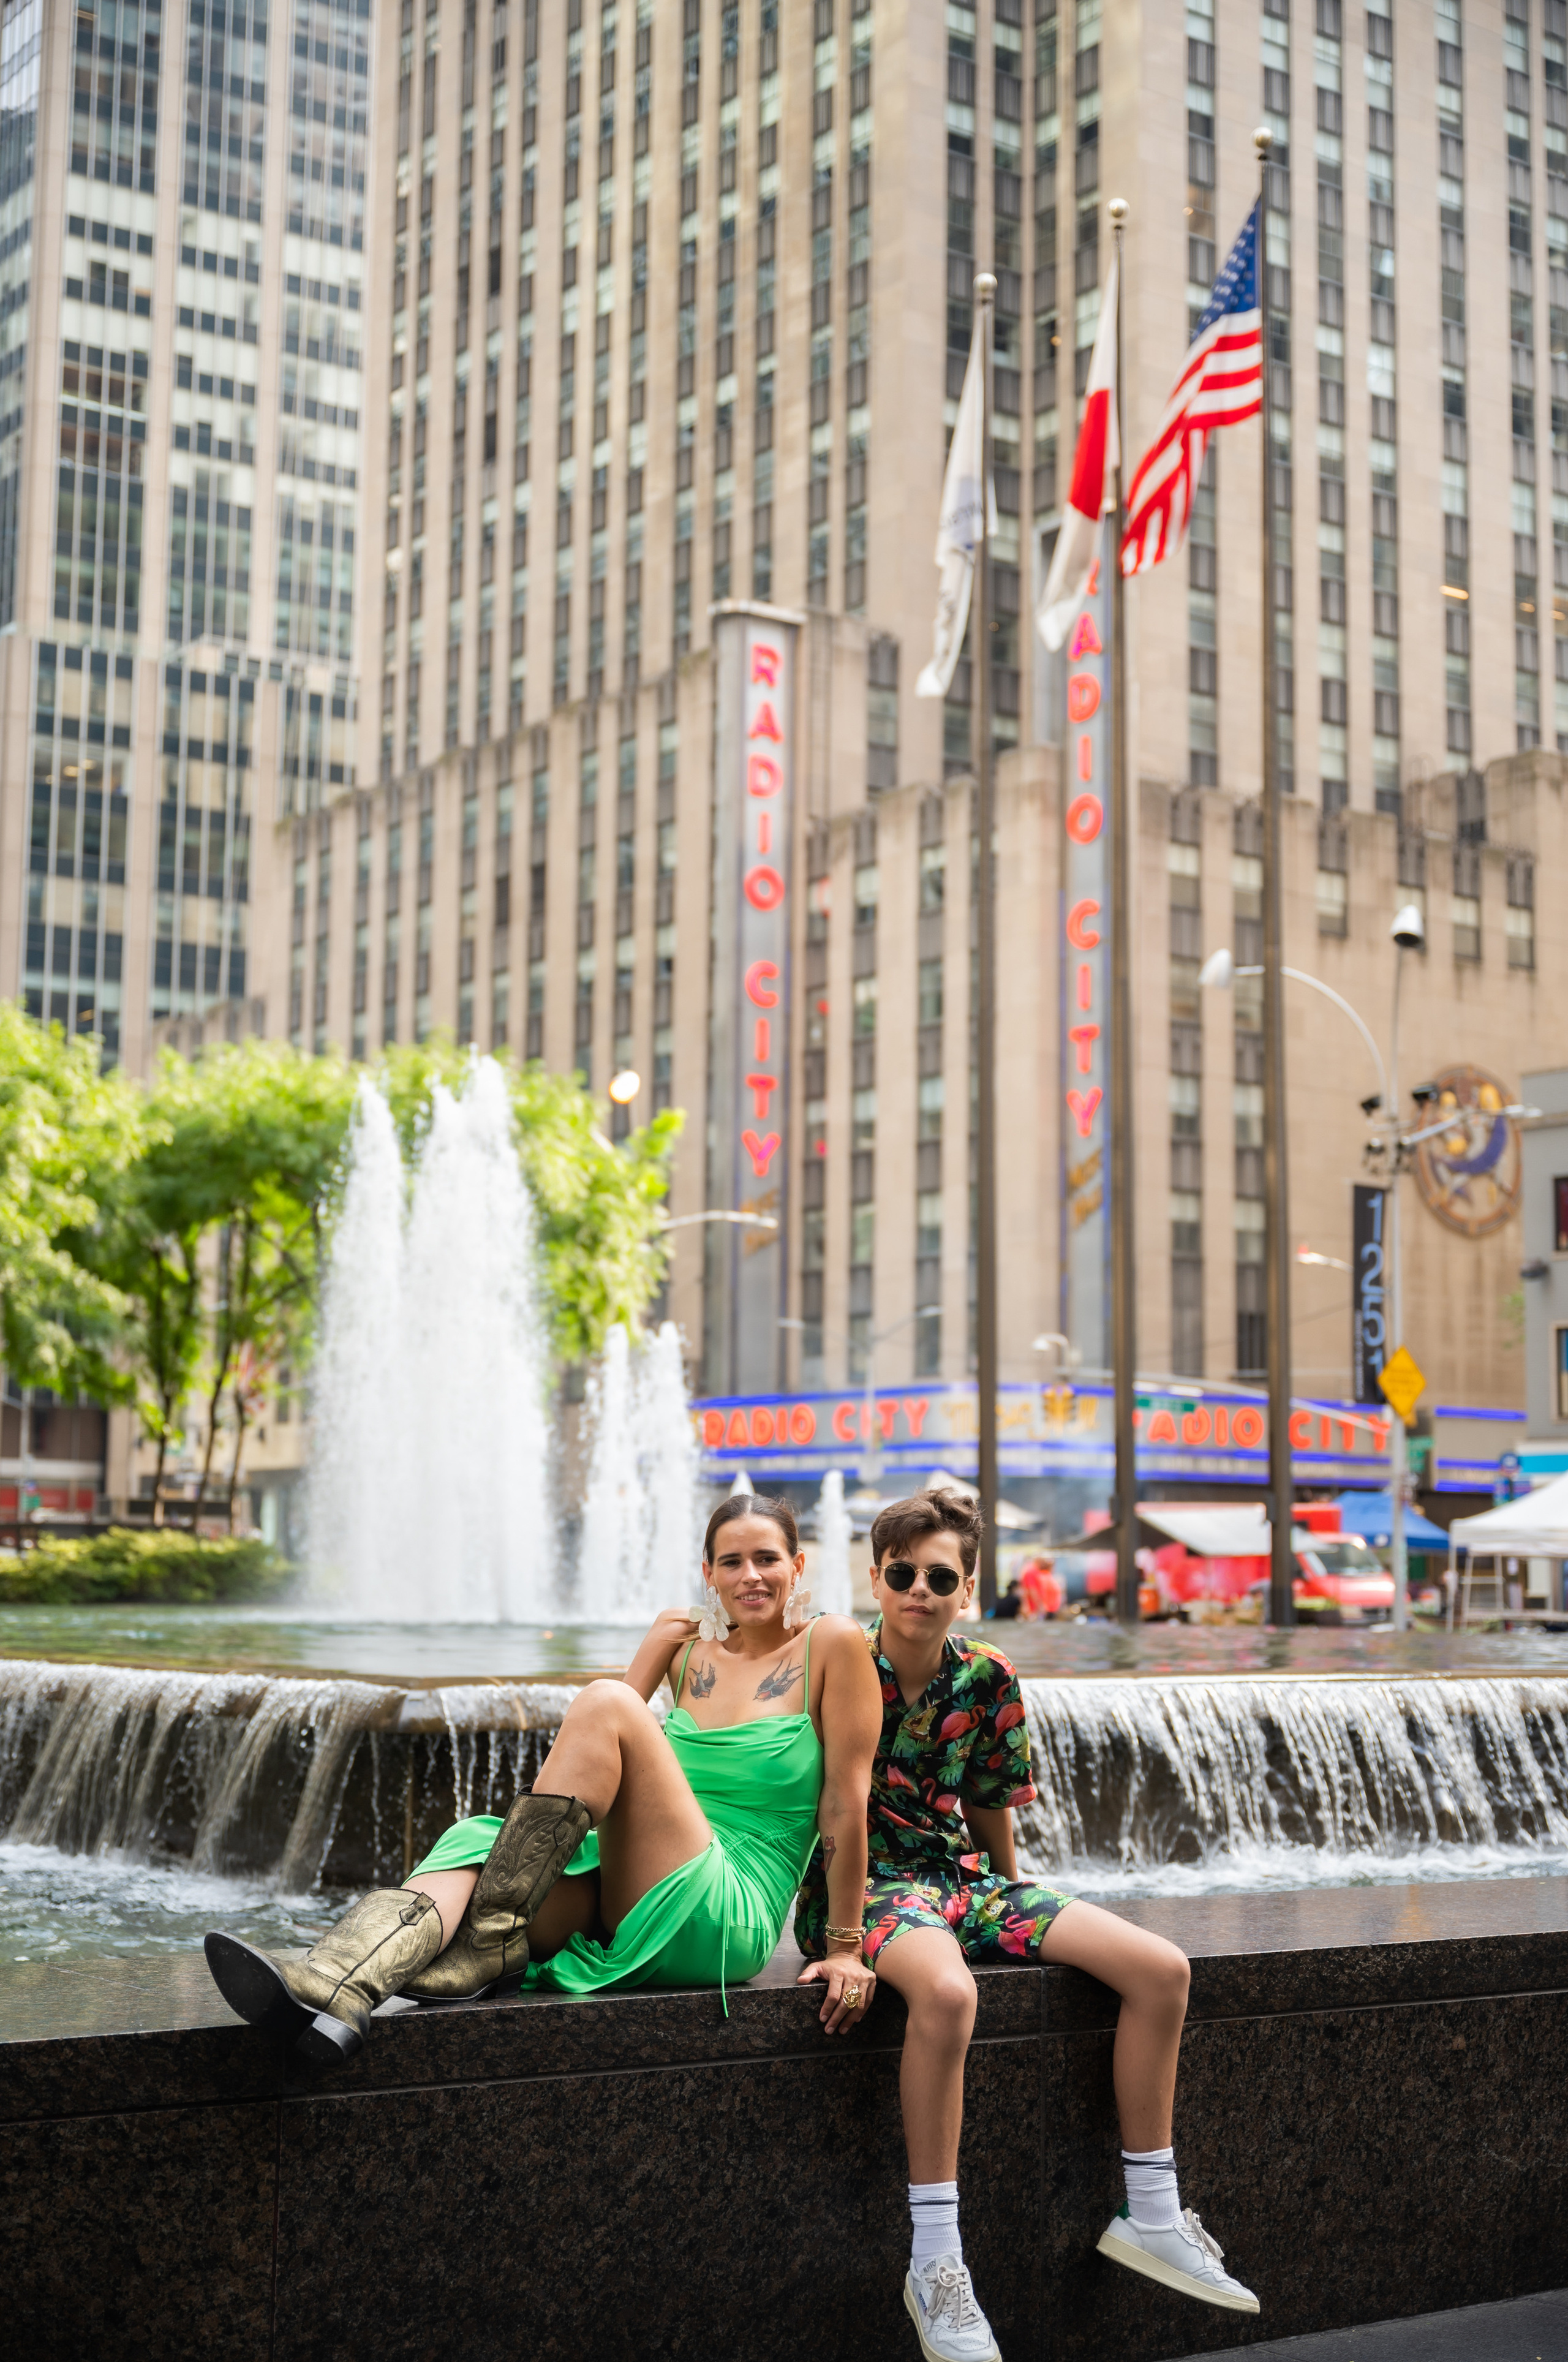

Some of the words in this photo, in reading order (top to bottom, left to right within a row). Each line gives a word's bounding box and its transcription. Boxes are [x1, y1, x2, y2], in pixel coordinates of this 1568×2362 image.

[744, 643, 785, 911] RADIO
[741, 959, 783, 1177] CITY
[1066, 898, 1103, 1138] CITY
[703, 1403, 816, 1448] RADIO
[832, 1397, 929, 1443] CITY
[1133, 1406, 1265, 1448] ADIO
[1288, 1409, 1392, 1452] CITY
